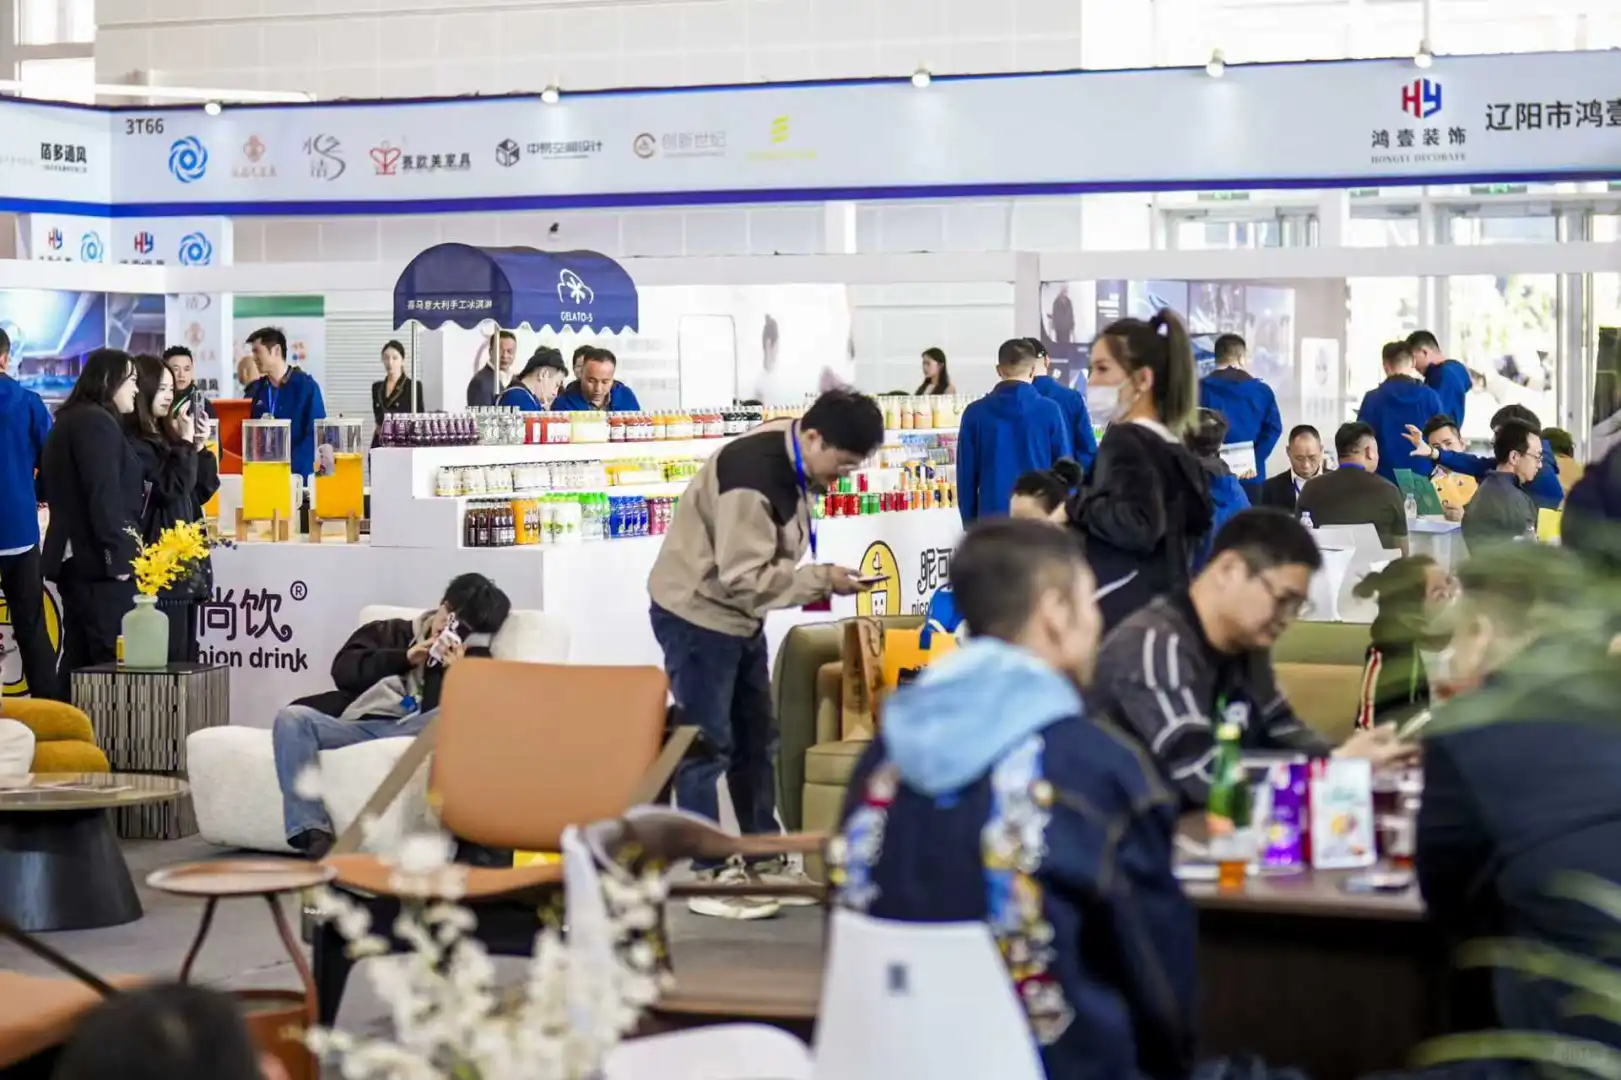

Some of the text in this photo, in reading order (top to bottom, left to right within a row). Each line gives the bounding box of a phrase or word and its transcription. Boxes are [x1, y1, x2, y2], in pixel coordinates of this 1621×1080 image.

[125, 118, 164, 135] 3T66
[1485, 98, 1621, 131] 辽阳市鸿壹
[1371, 127, 1467, 149] 鸿壹装饰
[917, 547, 957, 596] 昵可
[200, 587, 293, 643] 尚饮
[249, 646, 308, 673] drink
